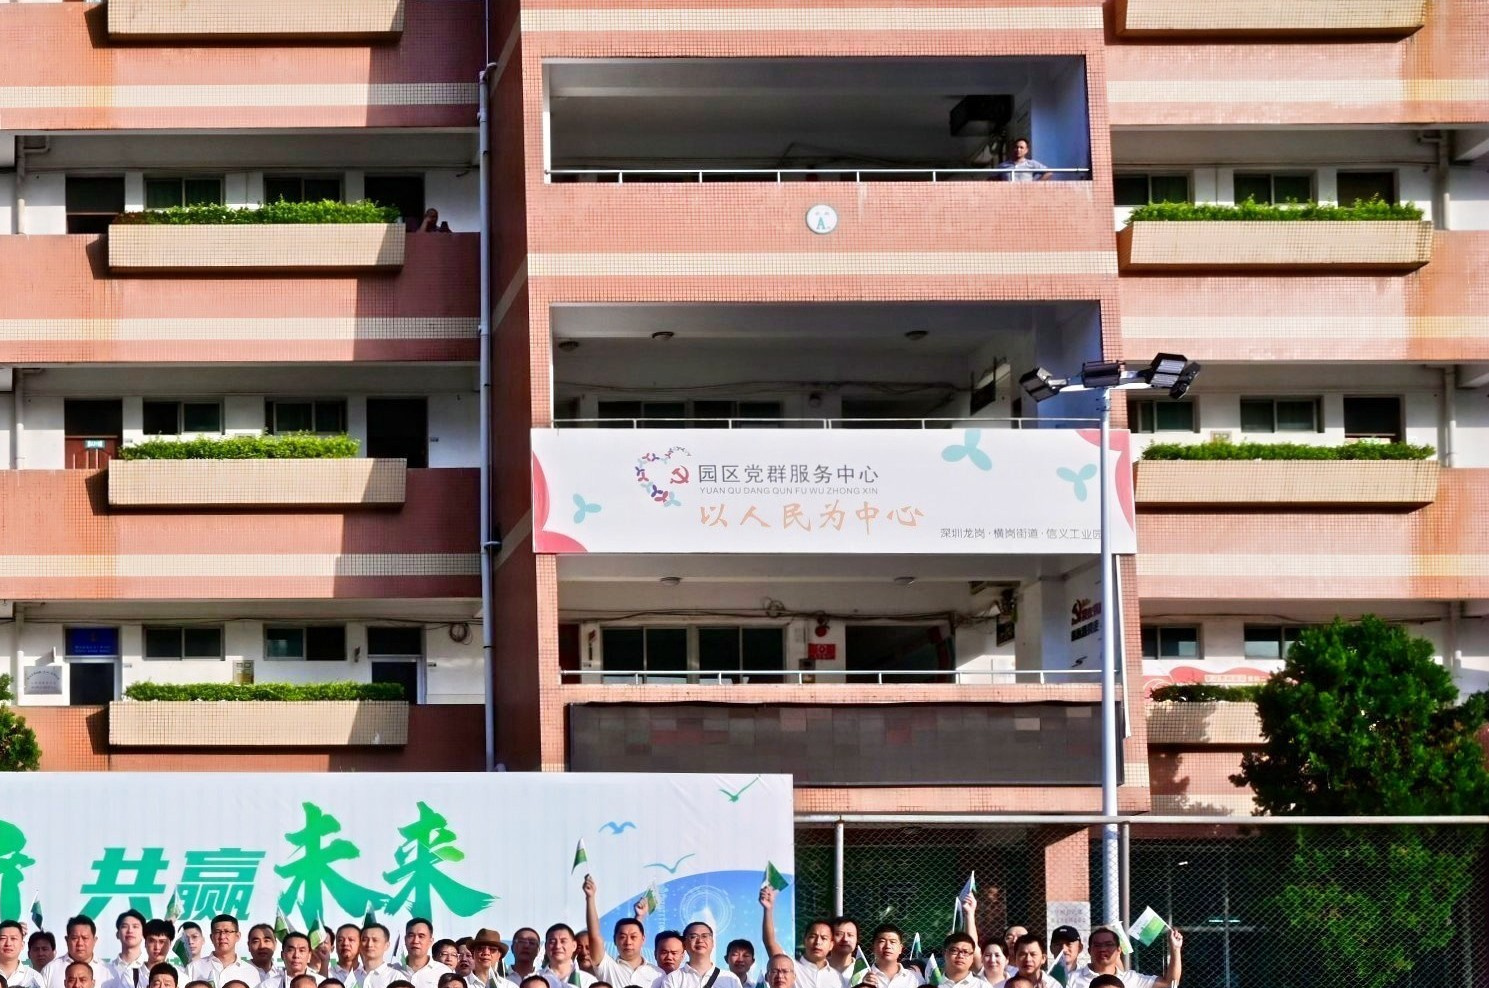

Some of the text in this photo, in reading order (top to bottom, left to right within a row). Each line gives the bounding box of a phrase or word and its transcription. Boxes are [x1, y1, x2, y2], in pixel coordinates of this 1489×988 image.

[698, 464, 880, 484] 园区党群服务中心
[700, 487, 879, 495] YUAN QU DANG QUN FU WU ZHONG XIN
[699, 499, 925, 535] 以人民为中心
[79, 800, 501, 922] 共赢未来
